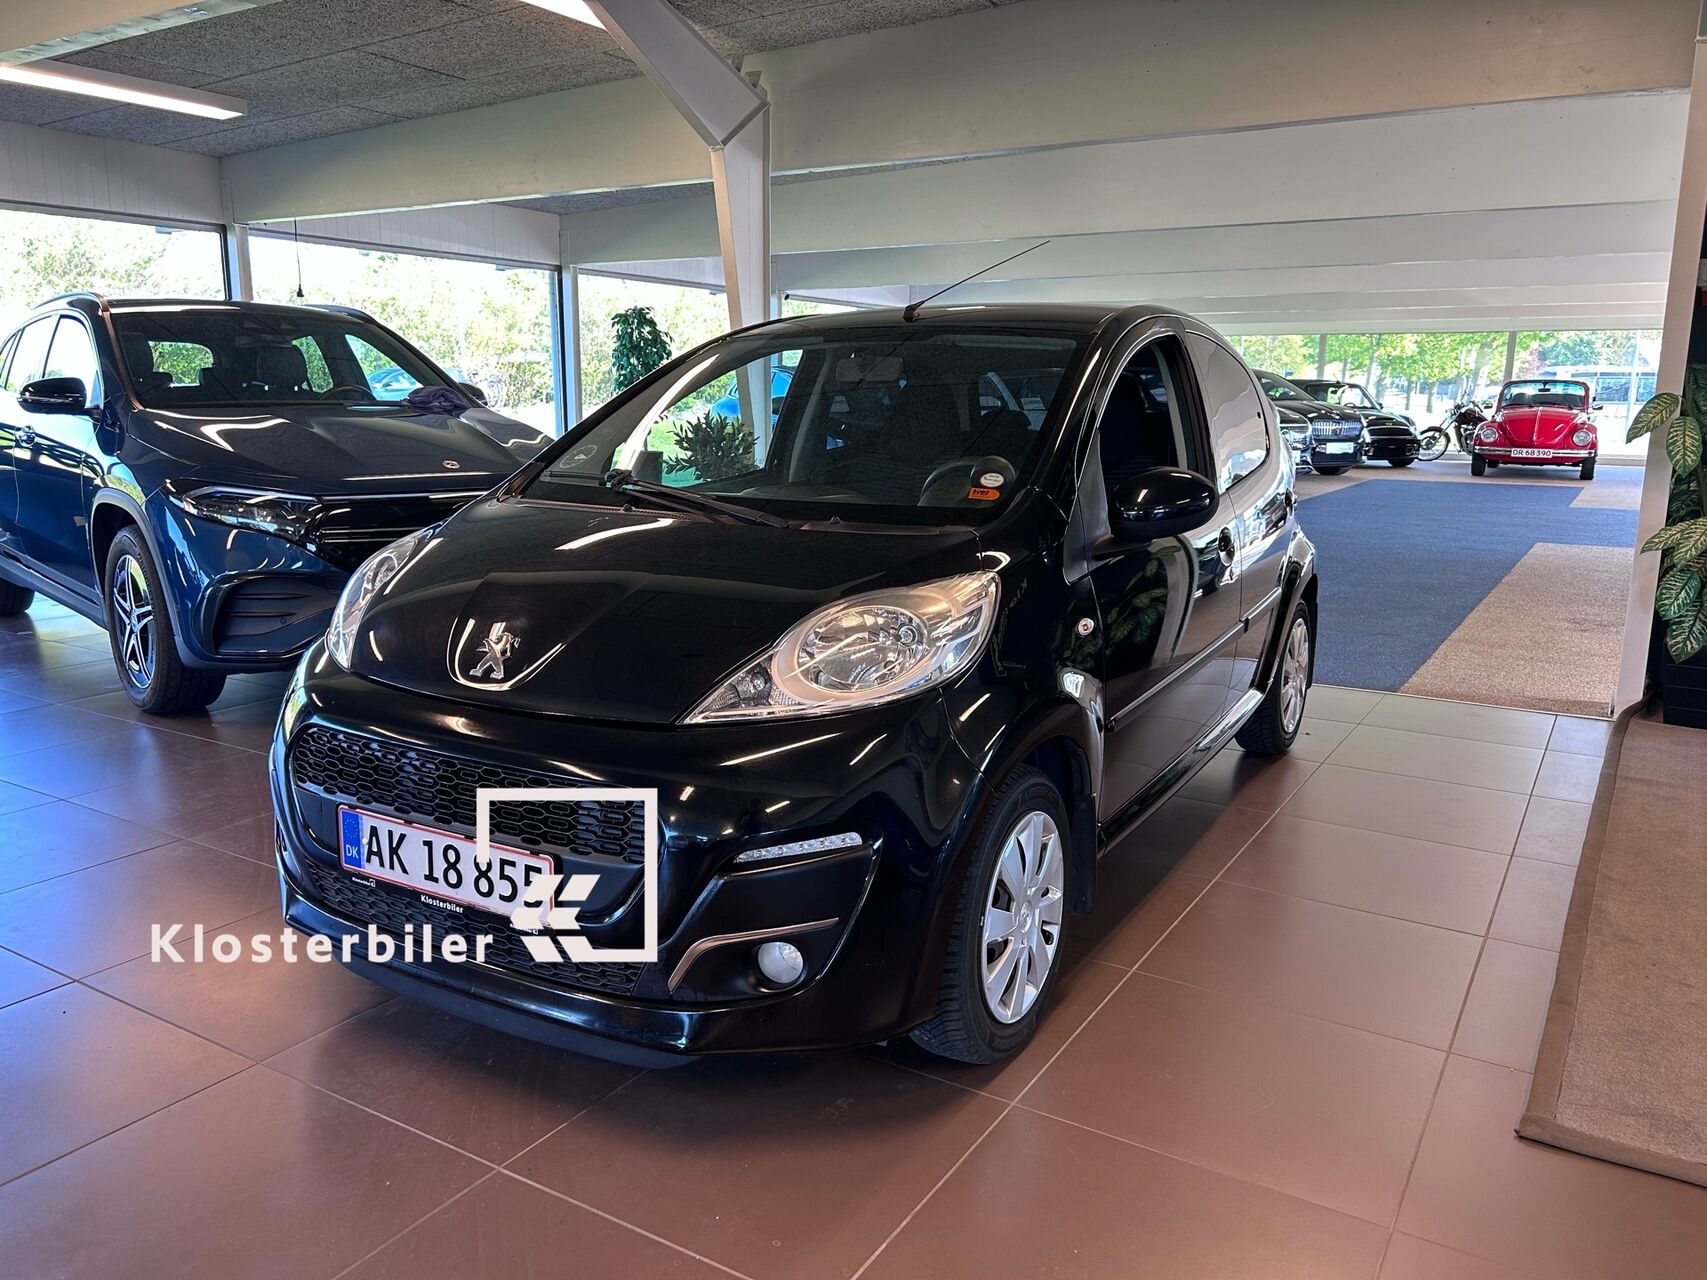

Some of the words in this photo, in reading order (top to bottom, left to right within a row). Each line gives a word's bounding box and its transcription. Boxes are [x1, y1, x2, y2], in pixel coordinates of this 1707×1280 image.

[1525, 449, 1536, 457] 68
[1536, 449, 1551, 457] 390
[345, 844, 359, 859] DK
[365, 824, 409, 876] AK
[422, 838, 464, 890] 18
[473, 852, 543, 908] 855
[420, 893, 464, 914] Klosterbiler
